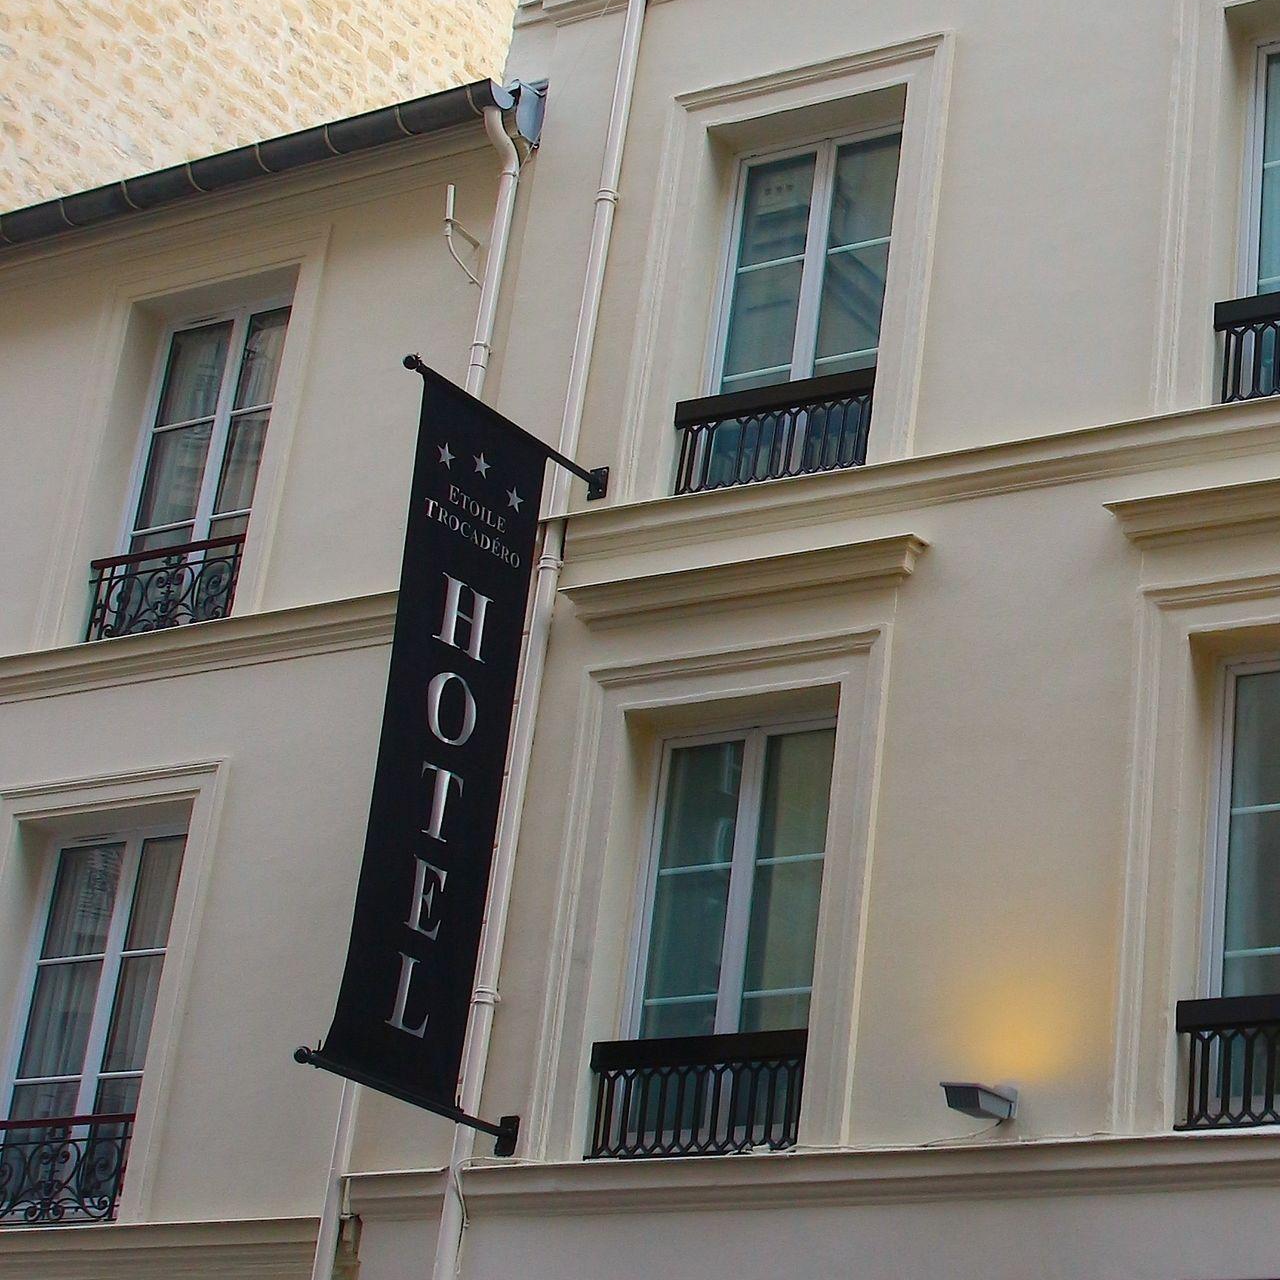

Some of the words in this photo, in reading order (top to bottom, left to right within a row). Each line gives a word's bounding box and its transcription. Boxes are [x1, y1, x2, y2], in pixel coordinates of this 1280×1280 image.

[424, 497, 521, 569] TROCADÉRO
[448, 483, 507, 534] ETOILE
[384, 571, 496, 1040] HOTEL
